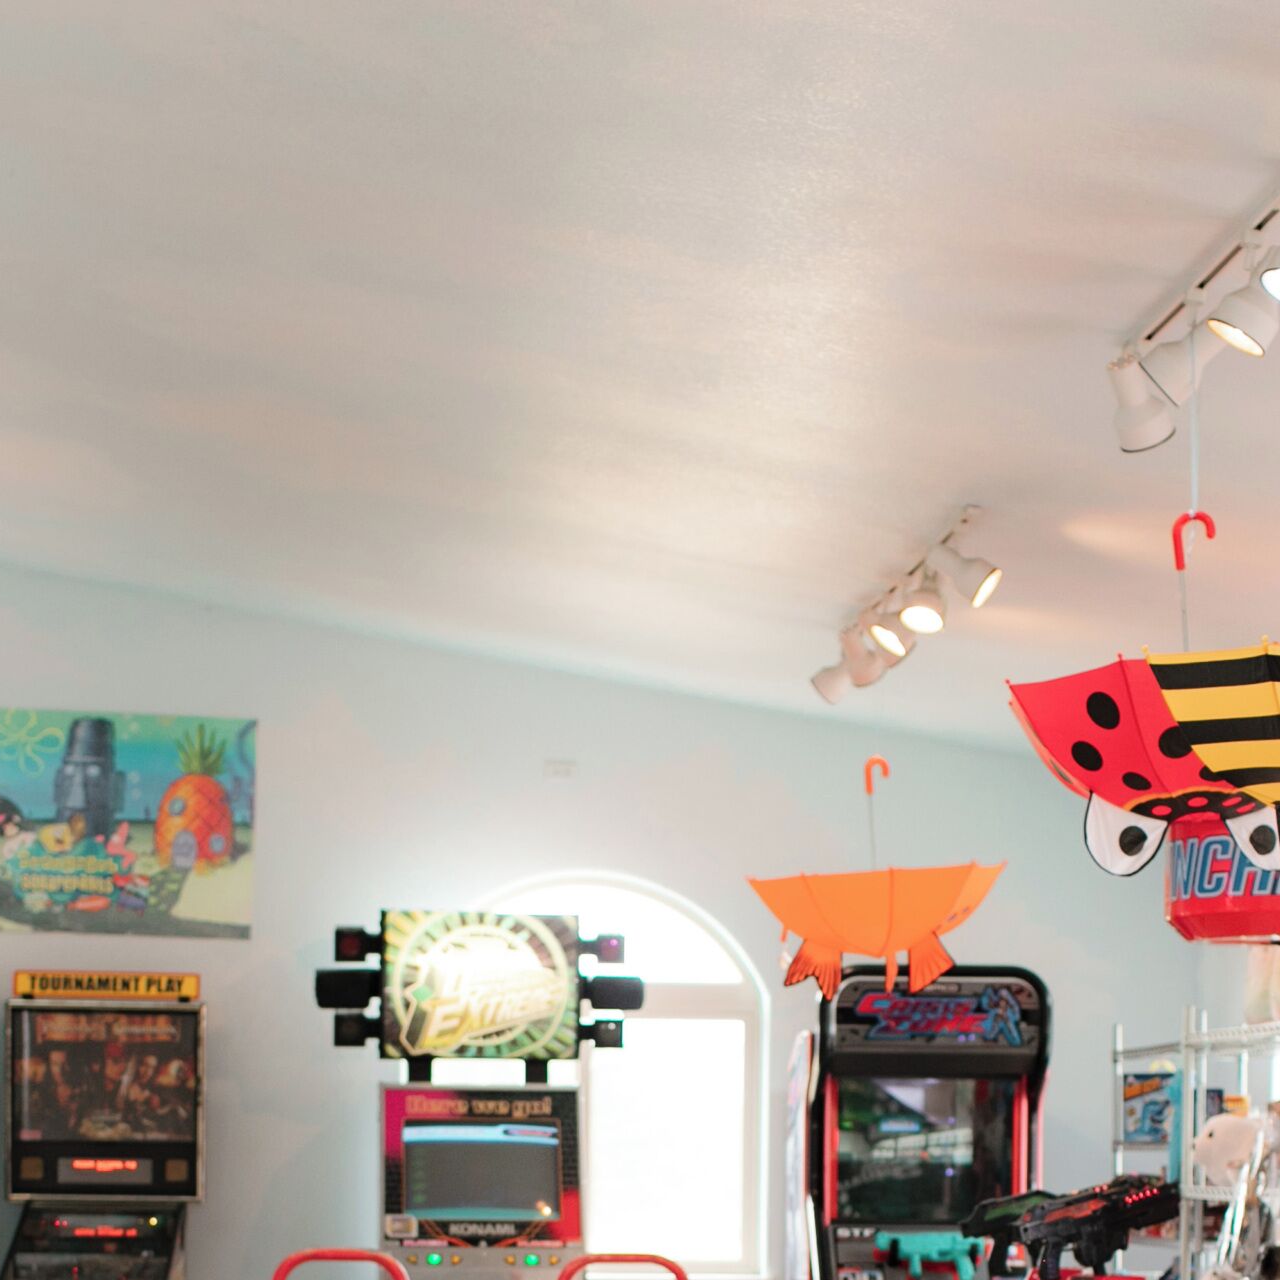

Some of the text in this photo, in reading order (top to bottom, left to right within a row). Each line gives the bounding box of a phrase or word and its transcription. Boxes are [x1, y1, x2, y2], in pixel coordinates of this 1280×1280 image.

[30, 976, 184, 993] TOURNAMENT PLAY
[448, 1223, 516, 1236] KONAMI
